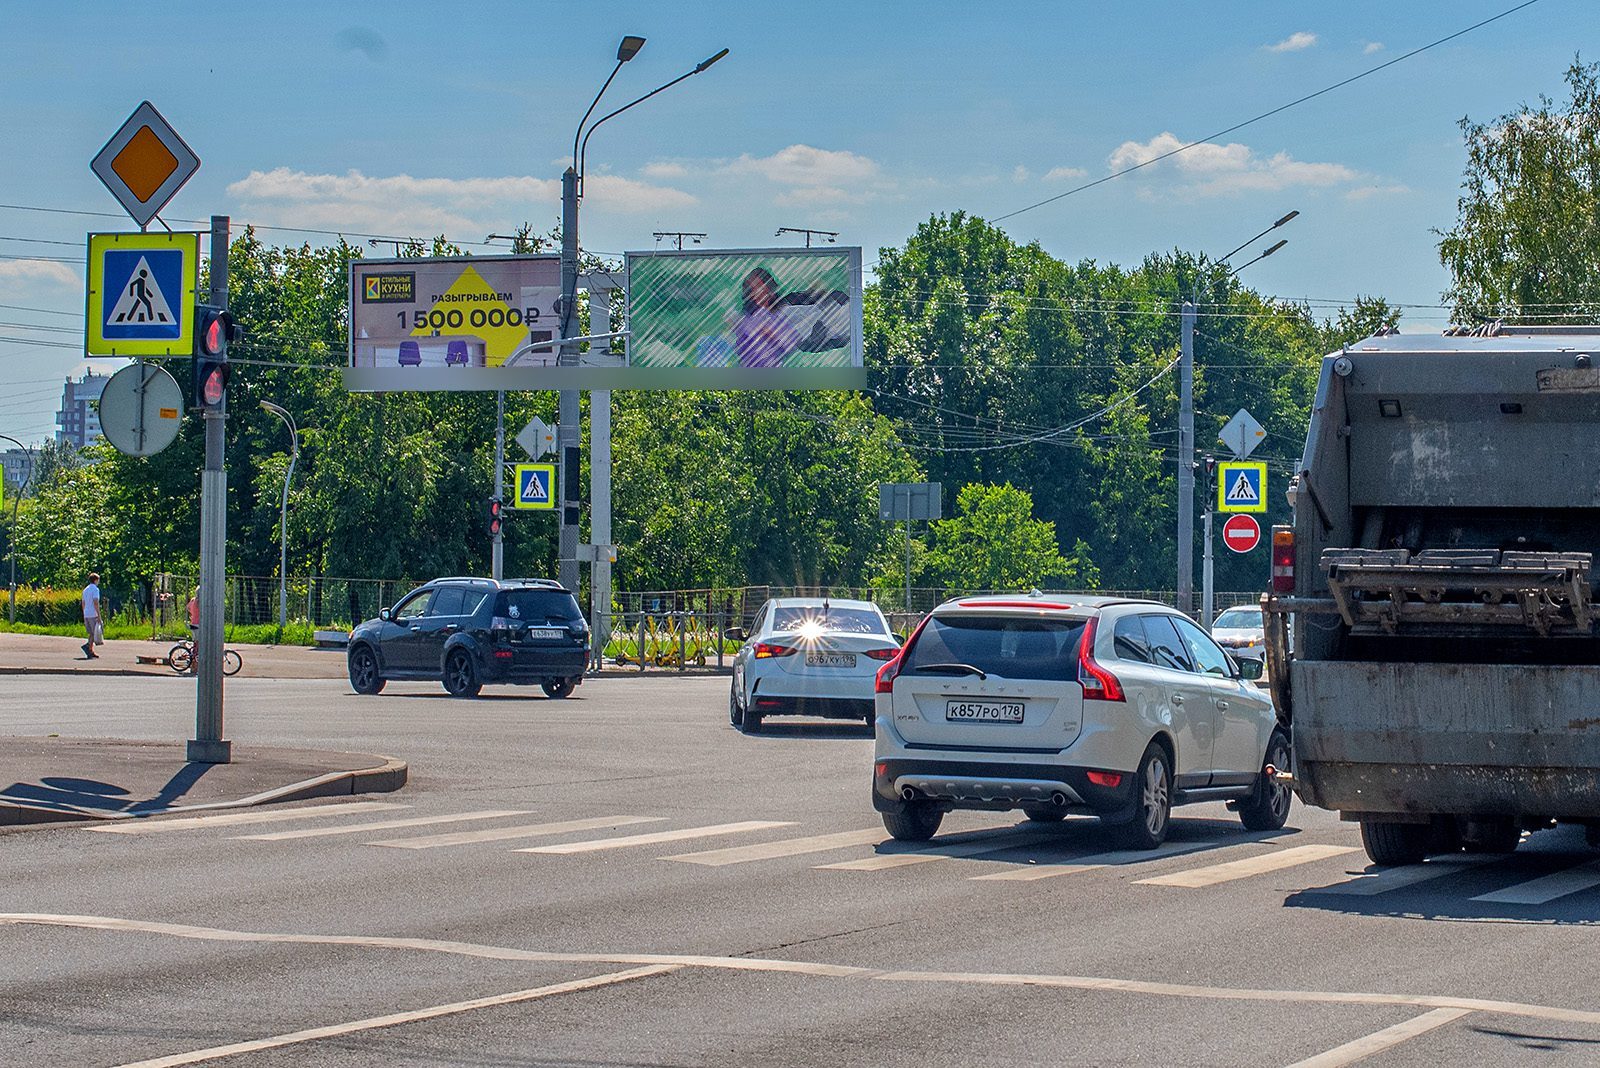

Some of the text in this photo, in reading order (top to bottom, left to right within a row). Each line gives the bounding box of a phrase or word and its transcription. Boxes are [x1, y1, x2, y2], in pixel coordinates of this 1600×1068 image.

[381, 283, 411, 293] КУХНИ
[431, 292, 513, 303] РАЗЫГРЫВАЕМ
[1001, 705, 1020, 716] 178
